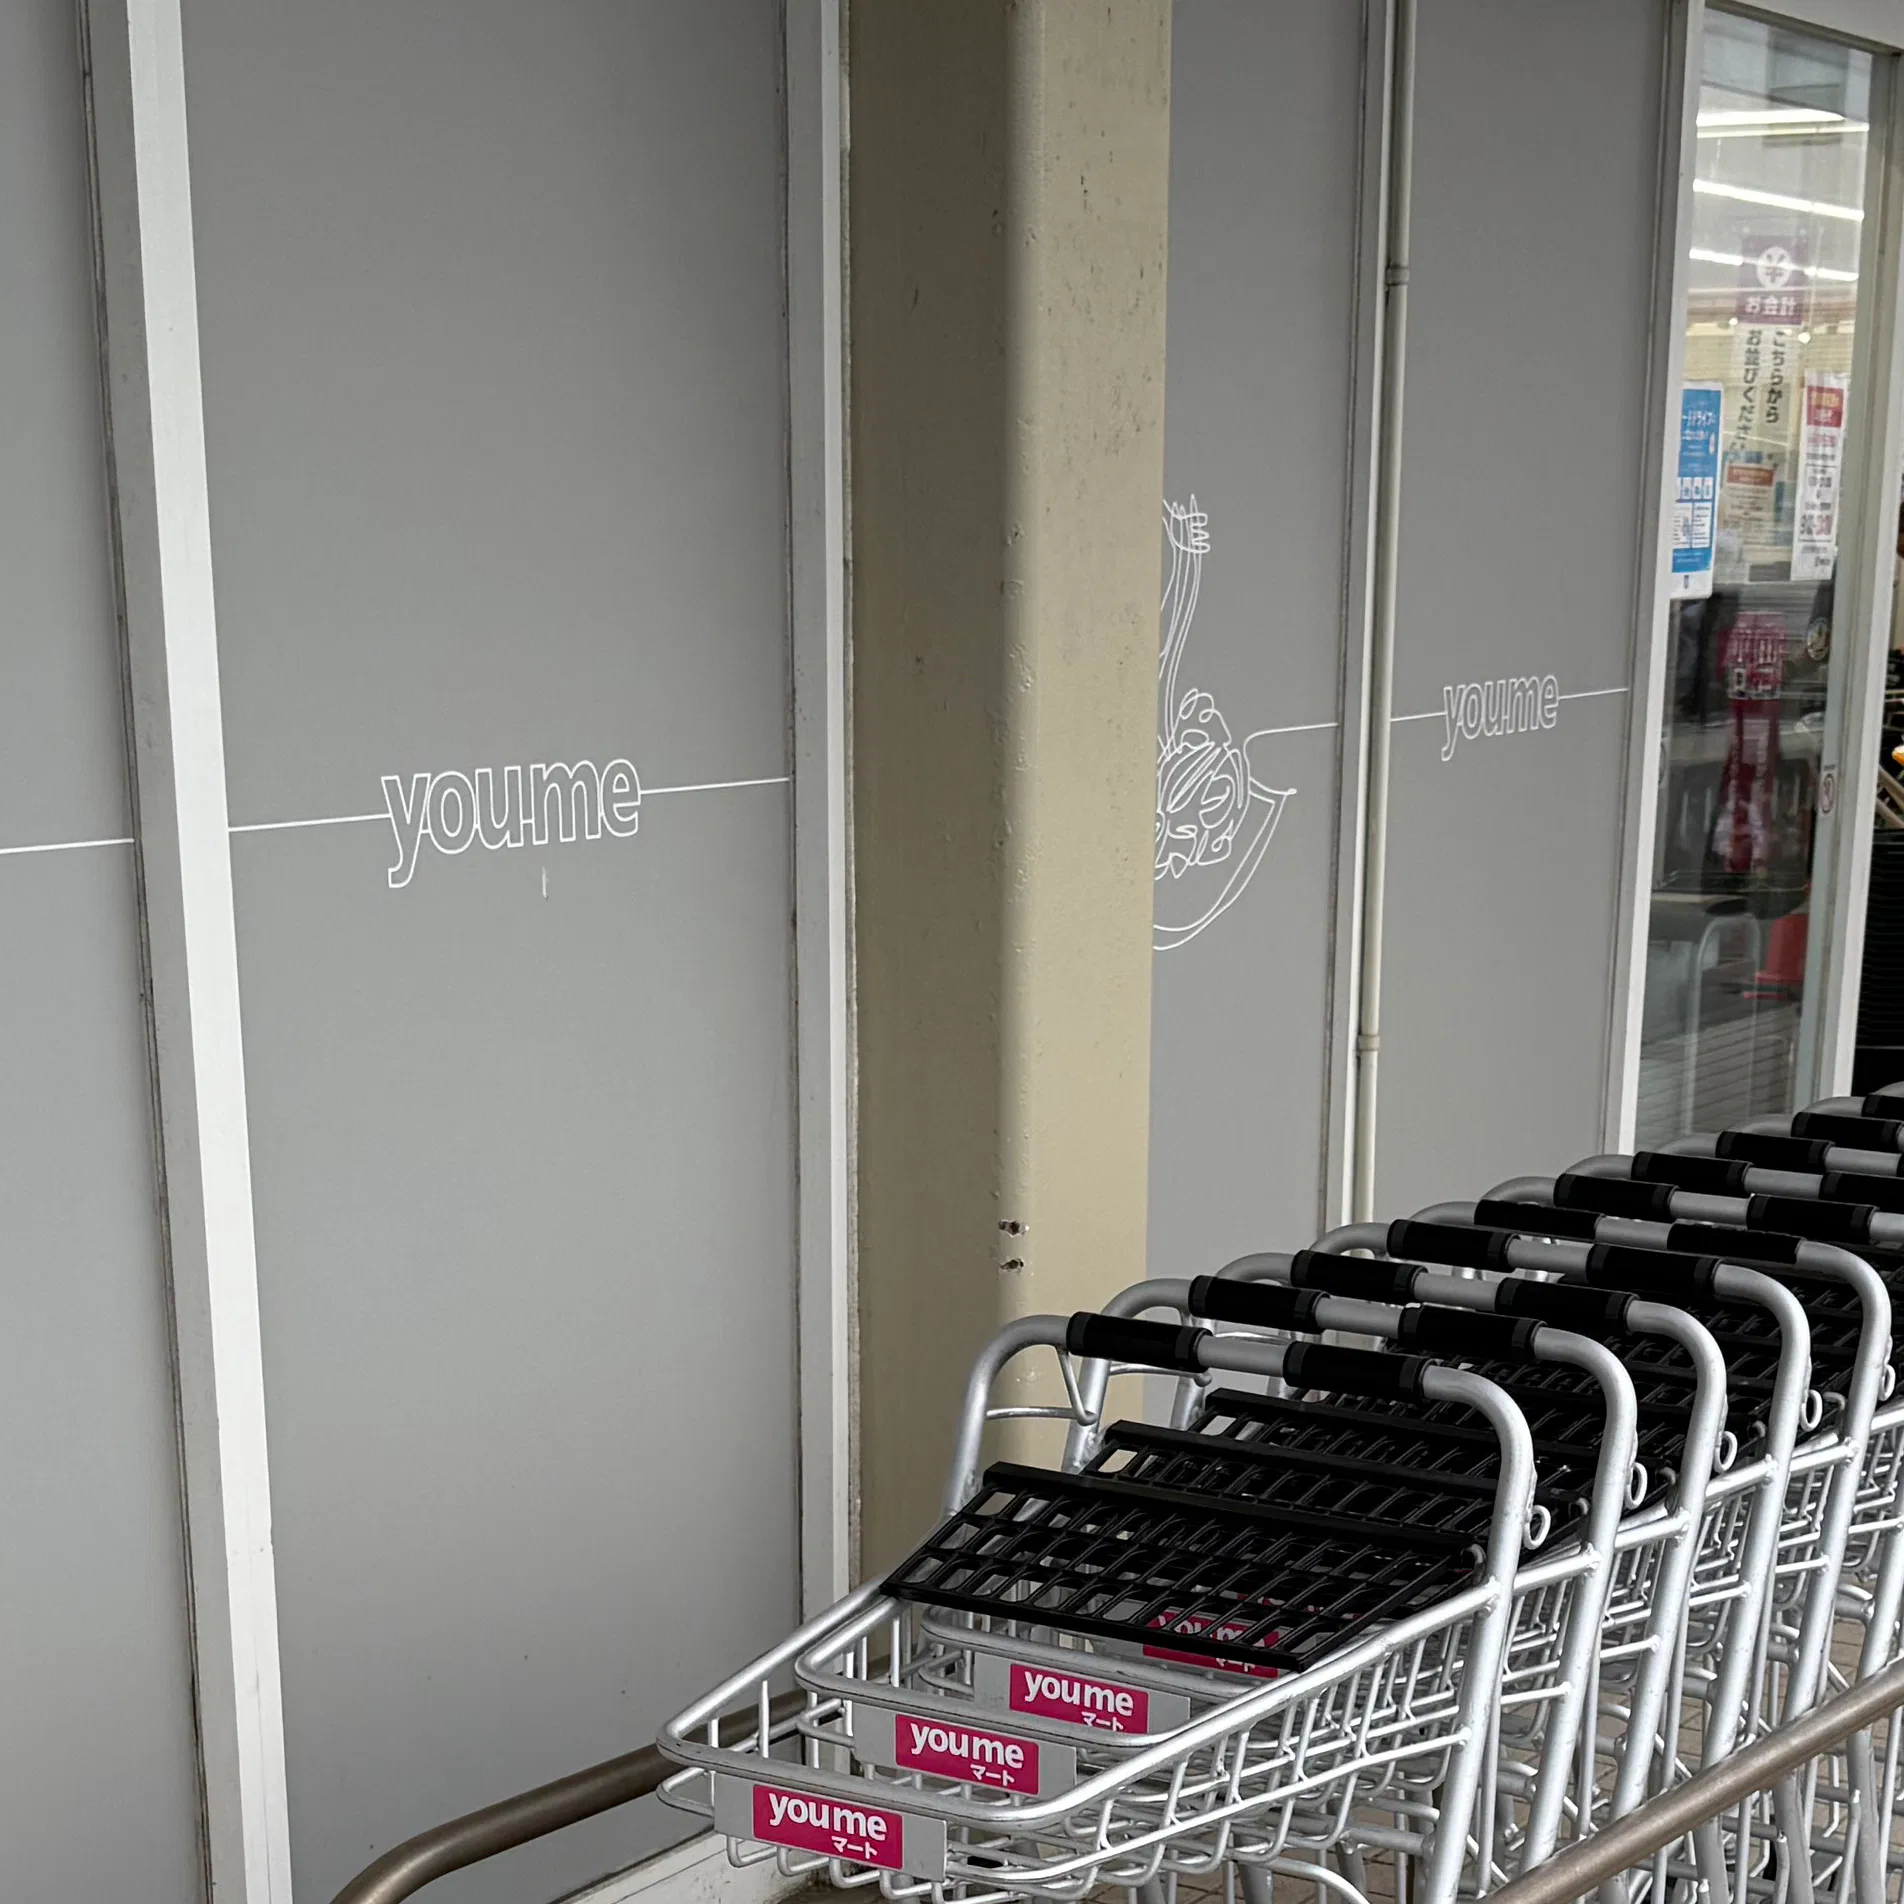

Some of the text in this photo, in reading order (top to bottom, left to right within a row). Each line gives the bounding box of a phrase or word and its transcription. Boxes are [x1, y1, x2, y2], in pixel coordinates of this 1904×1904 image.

[1441, 675, 1559, 761] youme
[381, 758, 642, 889] youme
[1024, 1671, 1134, 1716] youme
[911, 1723, 1024, 1768] youme
[970, 1764, 1015, 1787] マート
[768, 1793, 888, 1841] youme
[831, 1835, 878, 1859] マート
